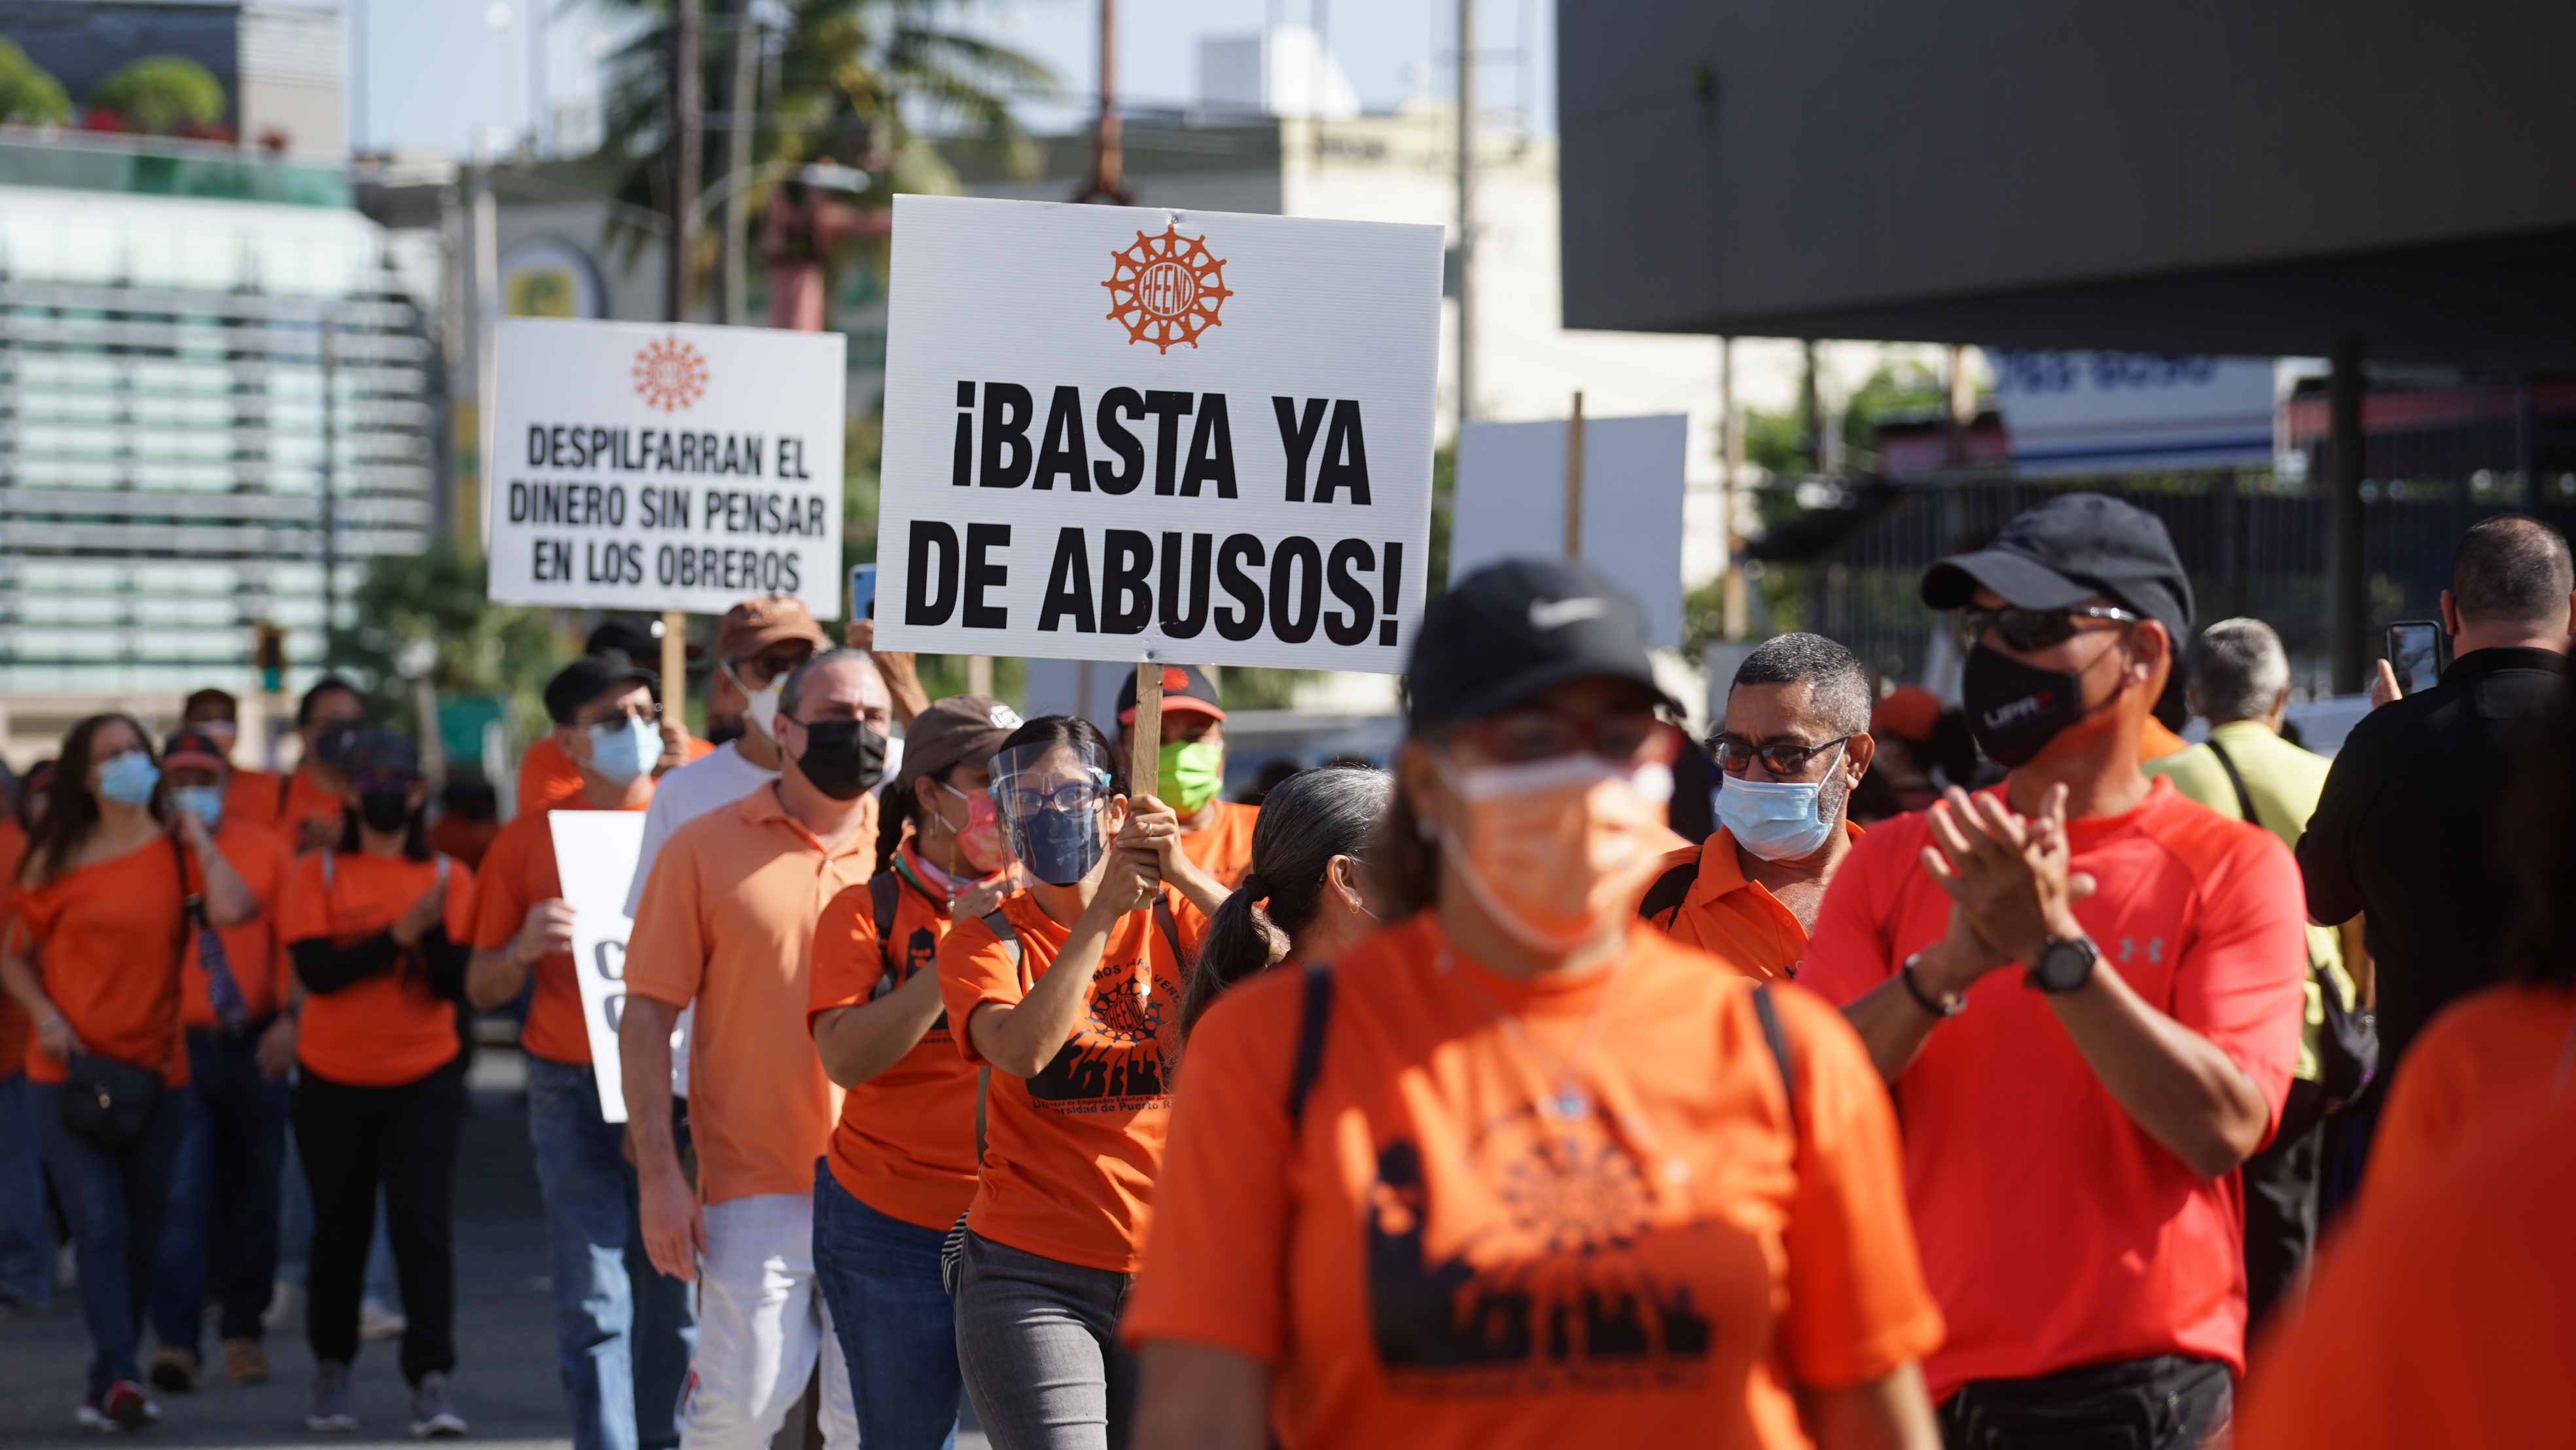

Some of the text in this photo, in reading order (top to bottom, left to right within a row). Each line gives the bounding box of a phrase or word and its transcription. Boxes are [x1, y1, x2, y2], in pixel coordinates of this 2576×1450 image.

[1142, 264, 1191, 314] HEEND
[527, 423, 810, 480] DESPILFARRAN EL
[952, 380, 1372, 506] ¡BASTA YA
[508, 480, 825, 537] DINERO SIN PENSAR
[532, 538, 800, 593] EN LOS OBREROS
[904, 520, 1403, 646] DE ABUSOS!
[1092, 964, 1121, 981] MOS
[1101, 1103, 1115, 1112] de
[1119, 1101, 1158, 1111] Puerto
